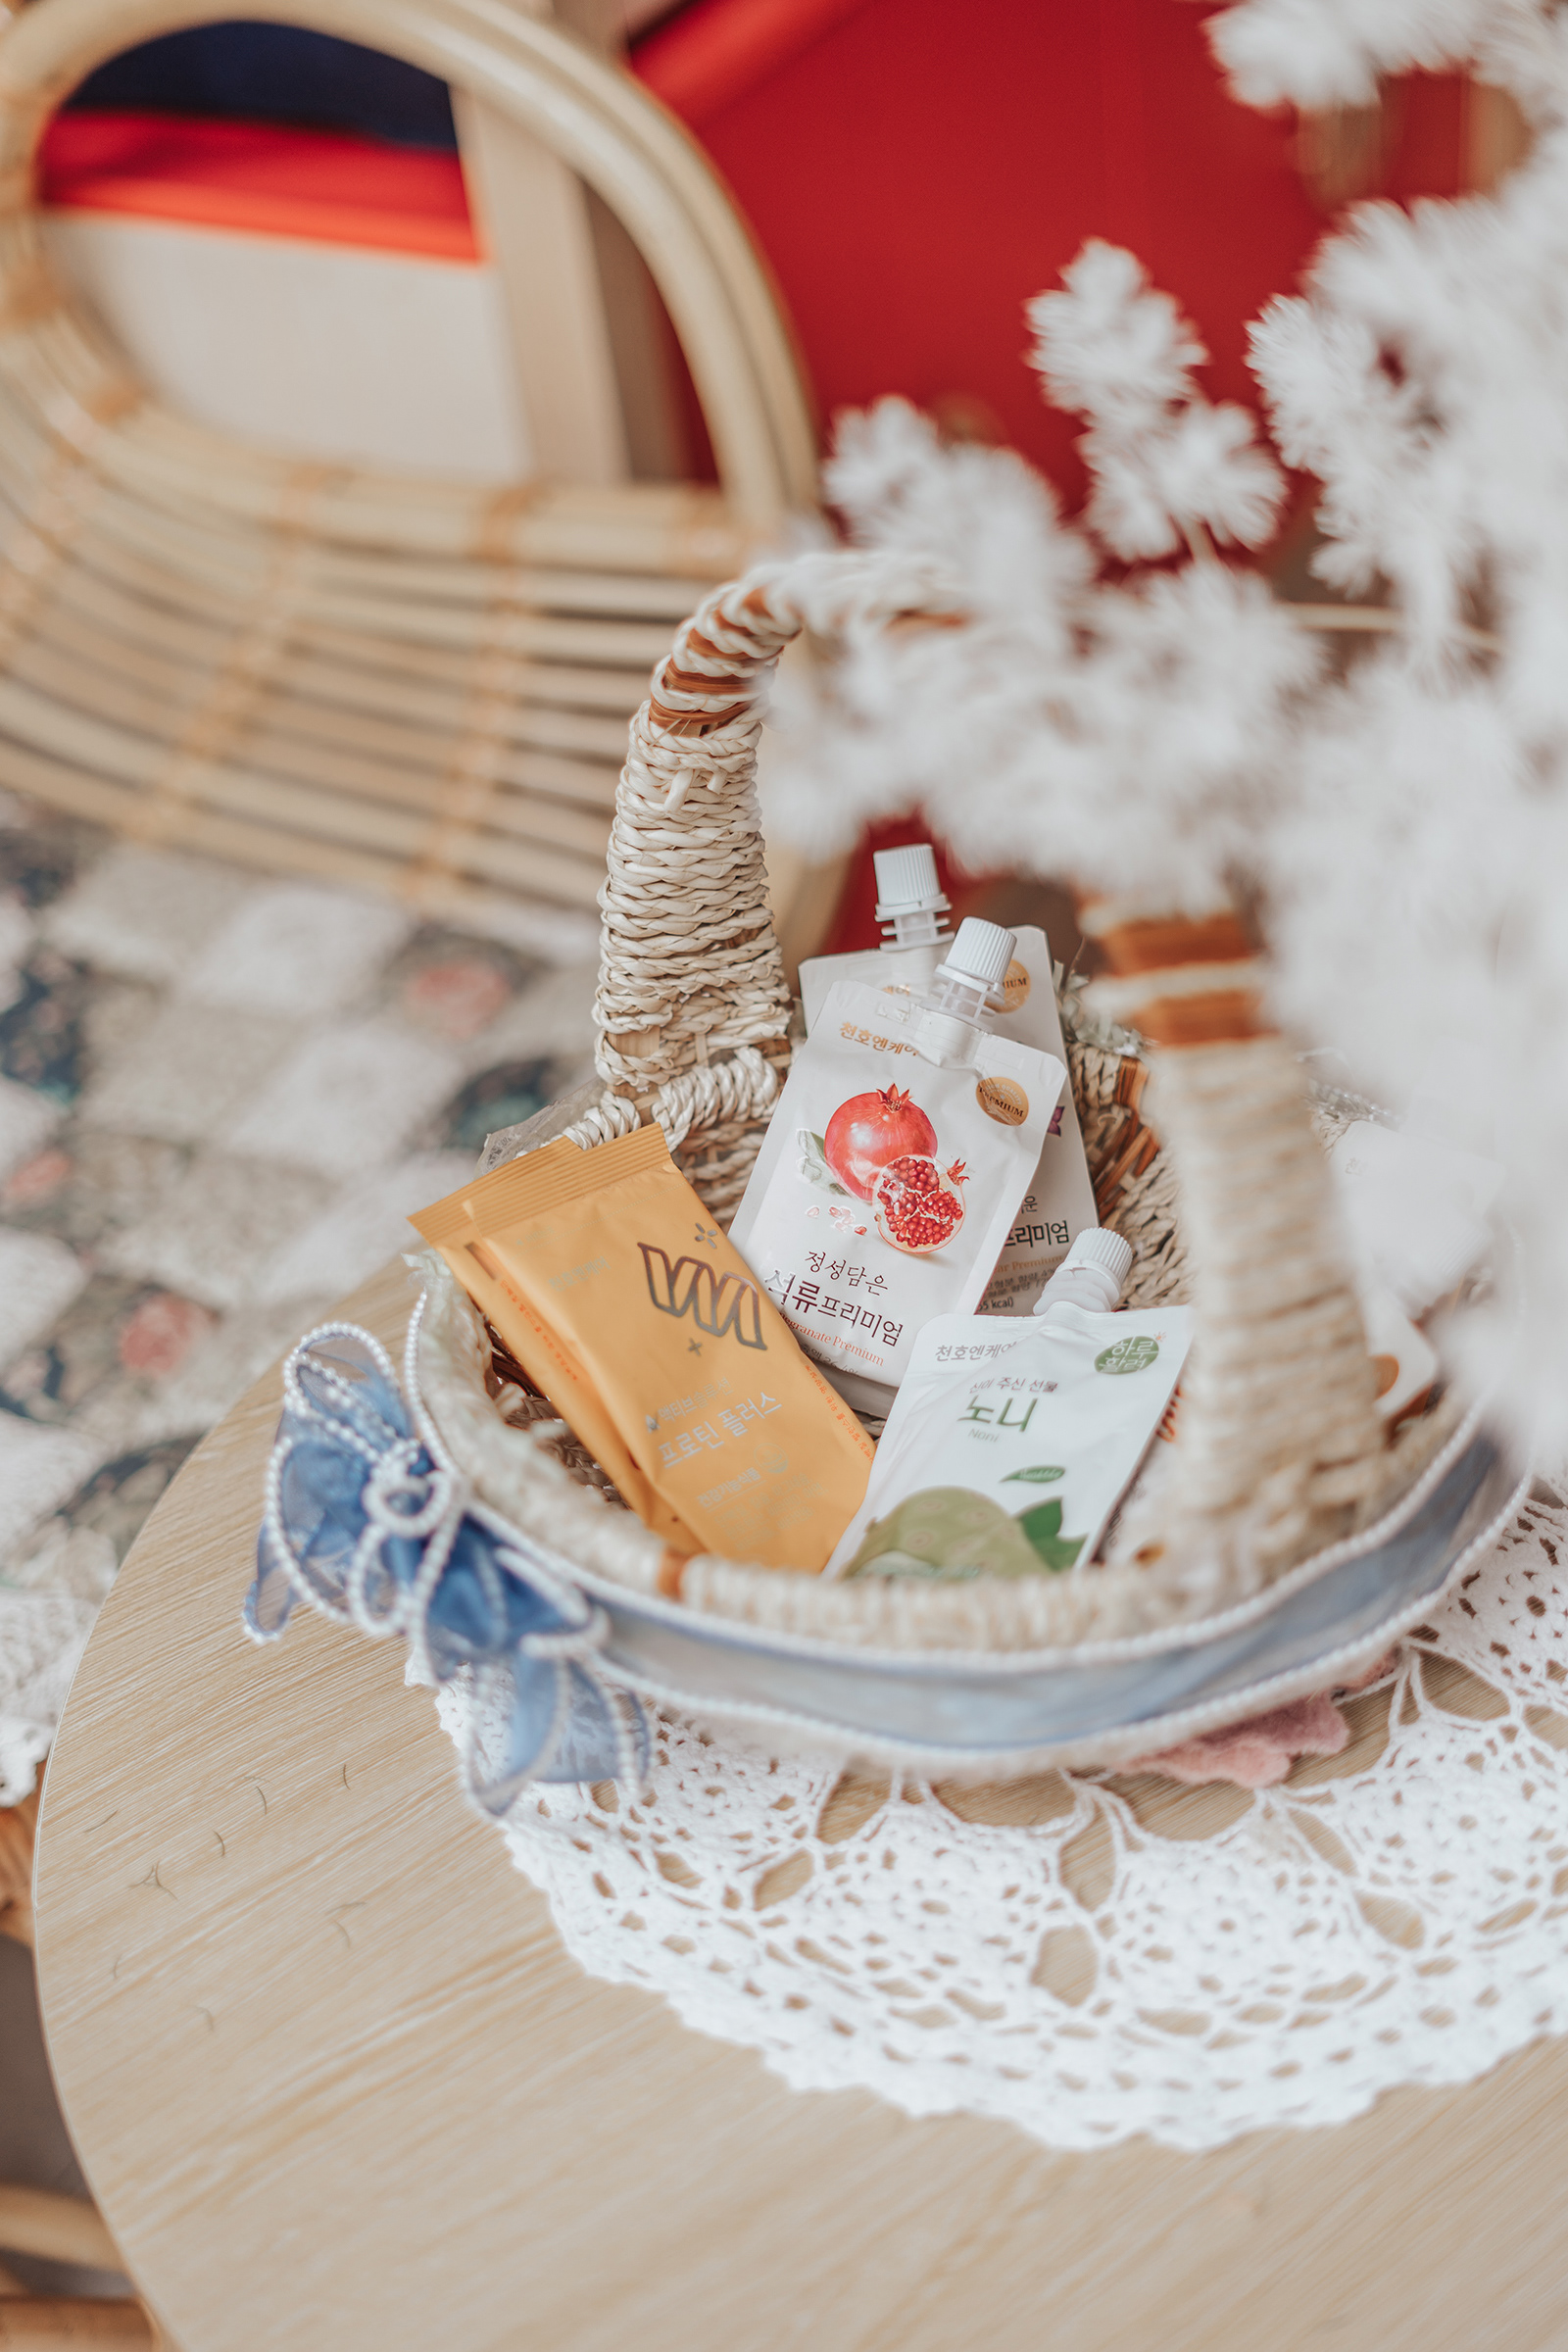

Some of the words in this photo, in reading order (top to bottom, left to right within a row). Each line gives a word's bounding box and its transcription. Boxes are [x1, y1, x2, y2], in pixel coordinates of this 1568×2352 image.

[805, 1250, 889, 1296] 정성담은
[1011, 1255, 1063, 1271] Premium
[779, 1312, 832, 1345] egranate
[832, 1335, 885, 1367] Premium
[1110, 1335, 1160, 1358] 하루
[996, 1377, 1027, 1393] 주신
[956, 1395, 1039, 1433] 노니
[658, 1421, 725, 1470] 프로틴
[716, 1392, 783, 1438] 플러스
[967, 1428, 1001, 1444] Noni
